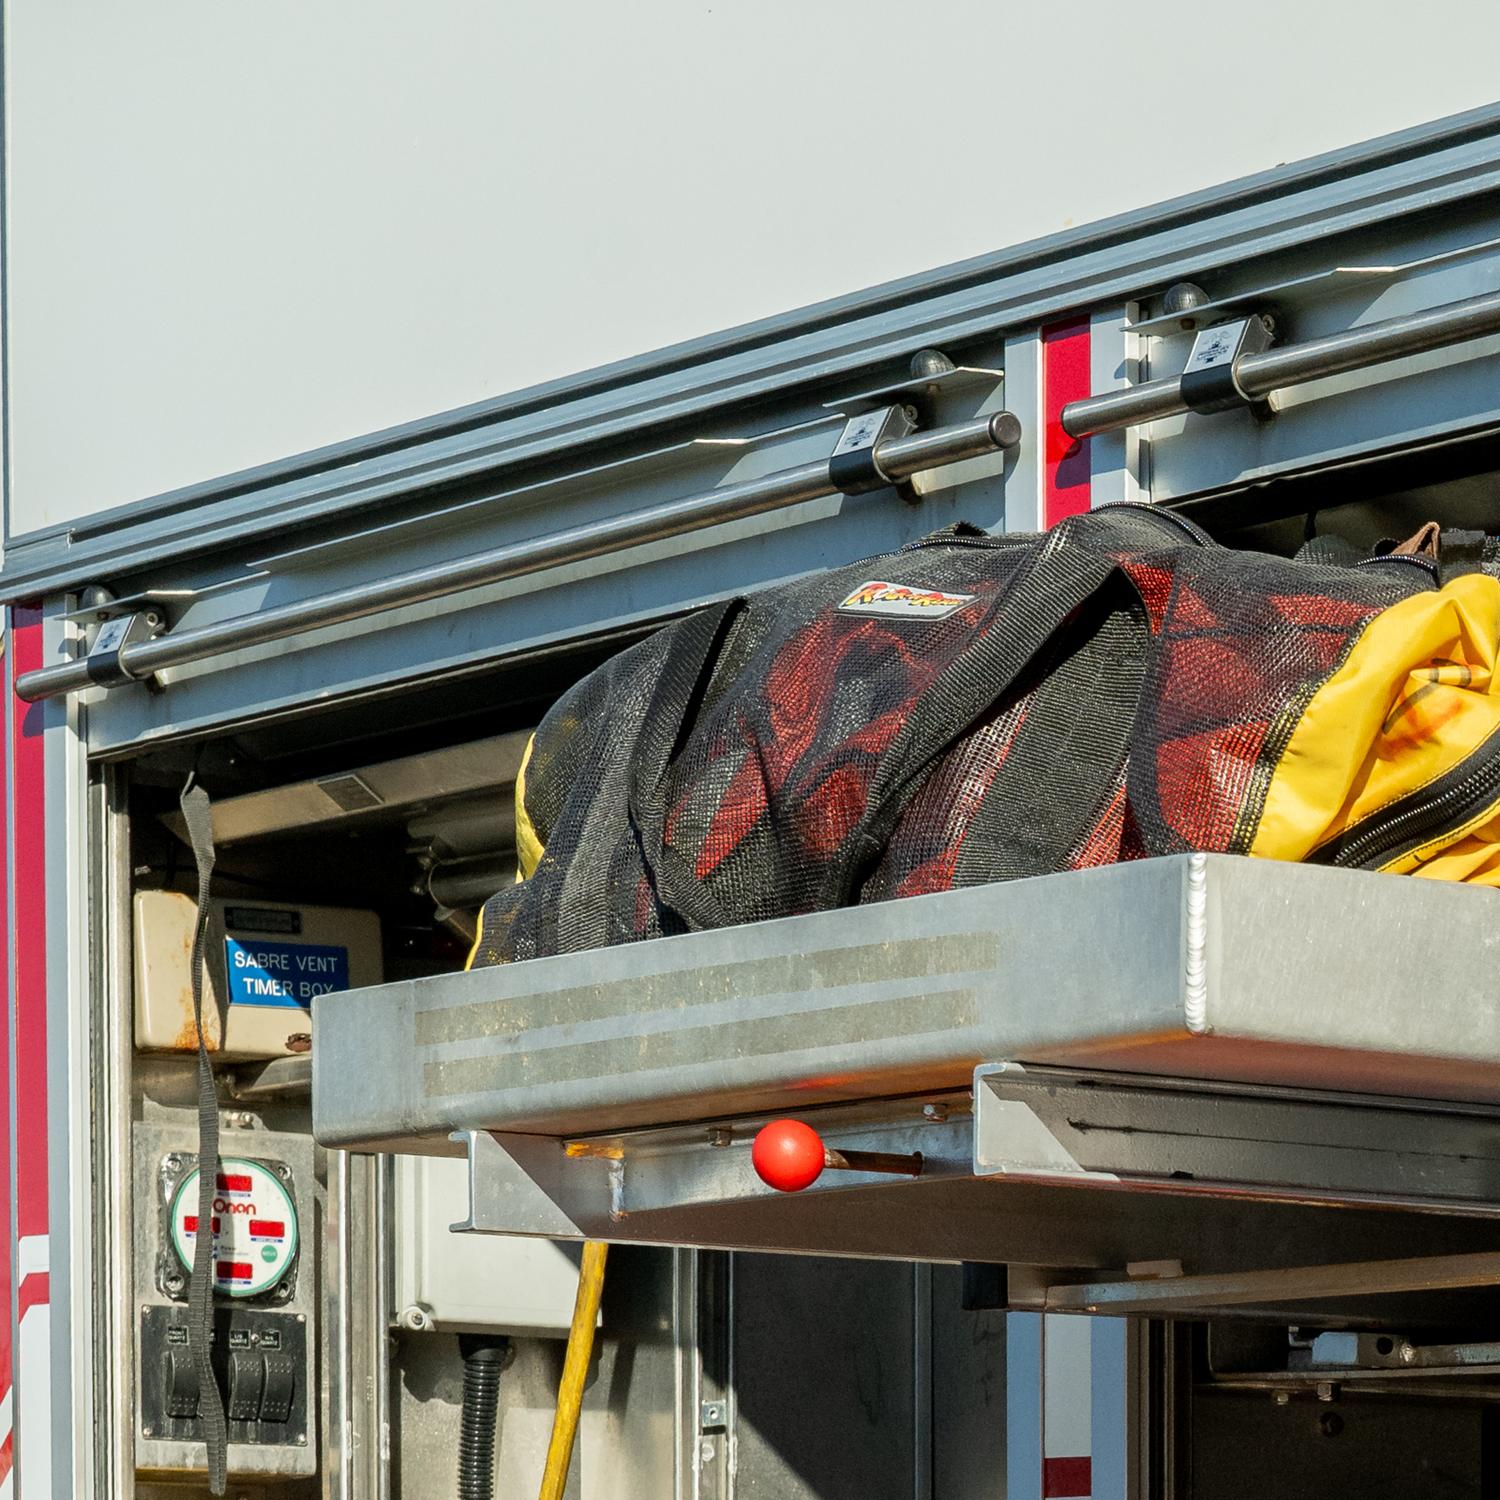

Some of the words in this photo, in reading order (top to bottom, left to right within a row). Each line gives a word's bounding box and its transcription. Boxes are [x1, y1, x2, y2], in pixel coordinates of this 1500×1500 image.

[234, 951, 290, 970] SABRE
[296, 955, 338, 973] VENT
[243, 978, 294, 996] TIMER
[213, 1198, 256, 1215] Onan
